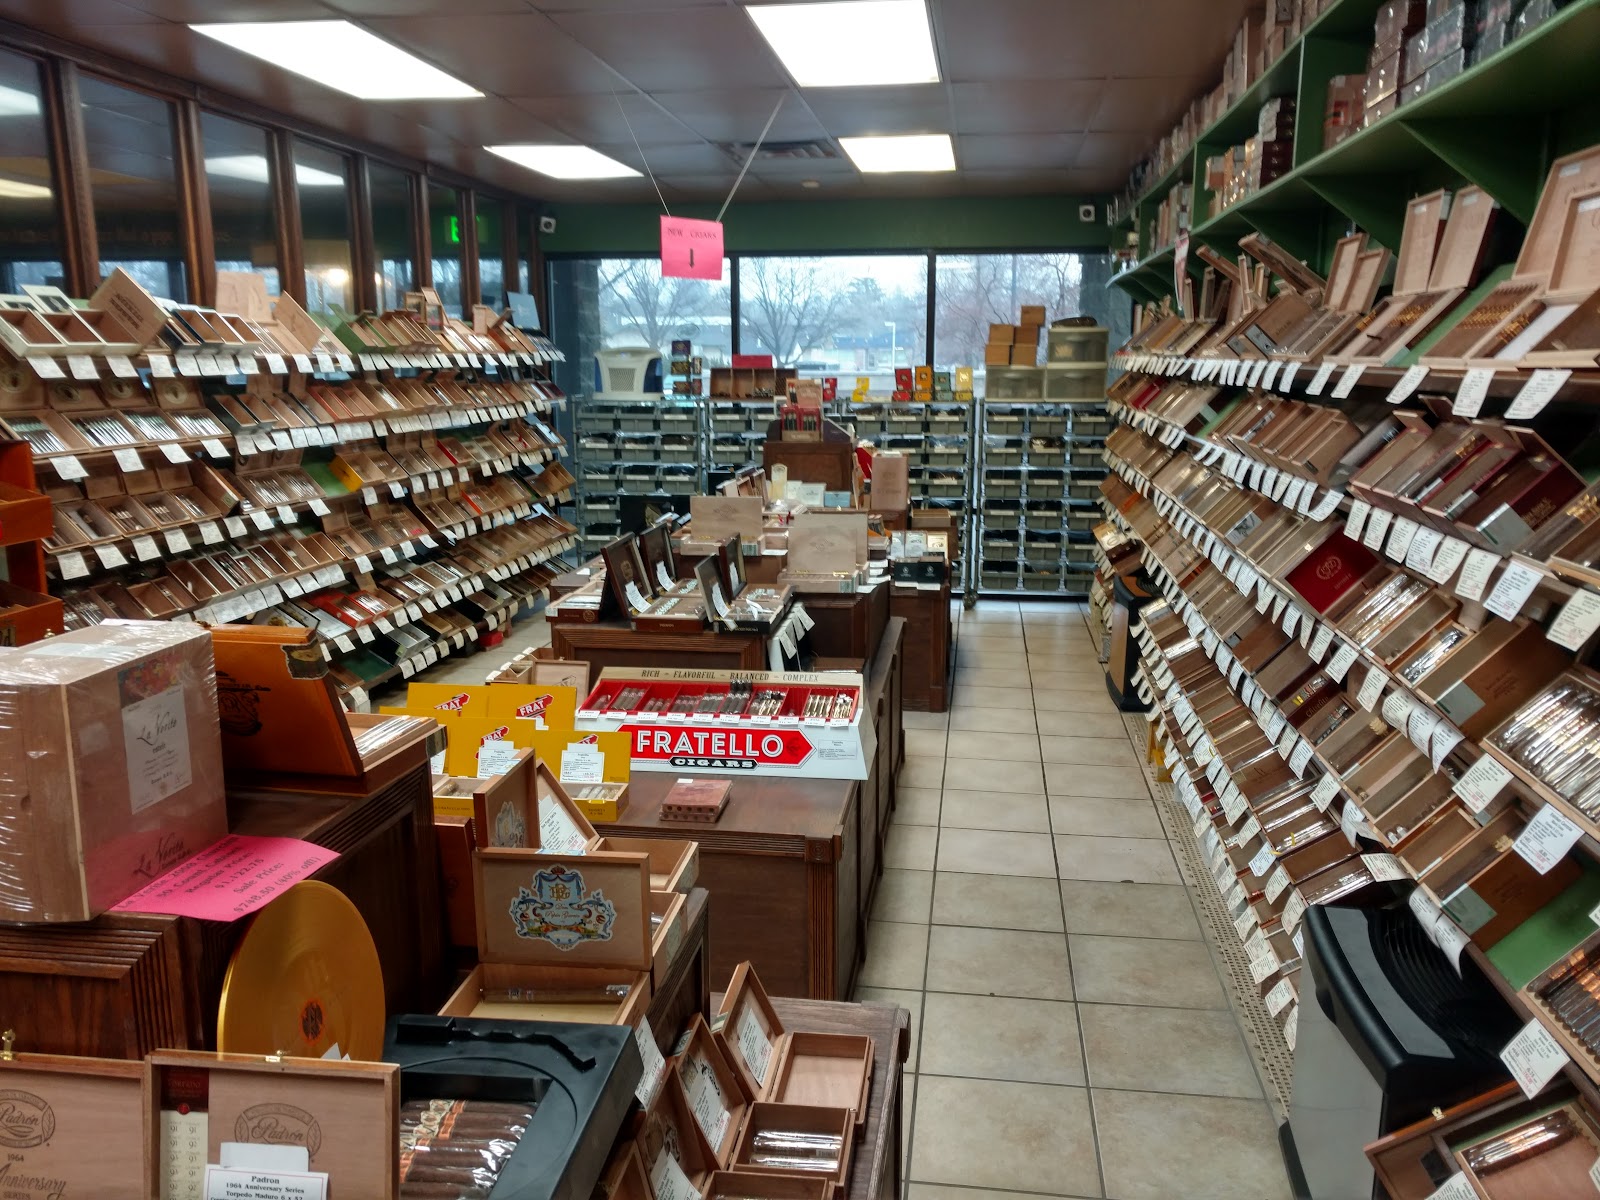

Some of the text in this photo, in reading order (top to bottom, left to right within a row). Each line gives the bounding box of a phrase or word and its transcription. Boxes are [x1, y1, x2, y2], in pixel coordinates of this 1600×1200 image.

[667, 228, 683, 237] NEW
[641, 670, 819, 682] RICH FLAVORFUL BALANCED COMPLEX
[519, 700, 545, 716] FRAT
[636, 730, 784, 758] FRATELLO
[674, 758, 754, 768] CIGARS
[185, 868, 224, 893] Regular
[233, 863, 284, 894] Sale Price:
[275, 869, 301, 886] (40%
[7, 1154, 24, 1162] 1964
[251, 1176, 280, 1184] Padron
[245, 1184, 282, 1193] Anniversary
[226, 1191, 253, 1199] Torpedo
